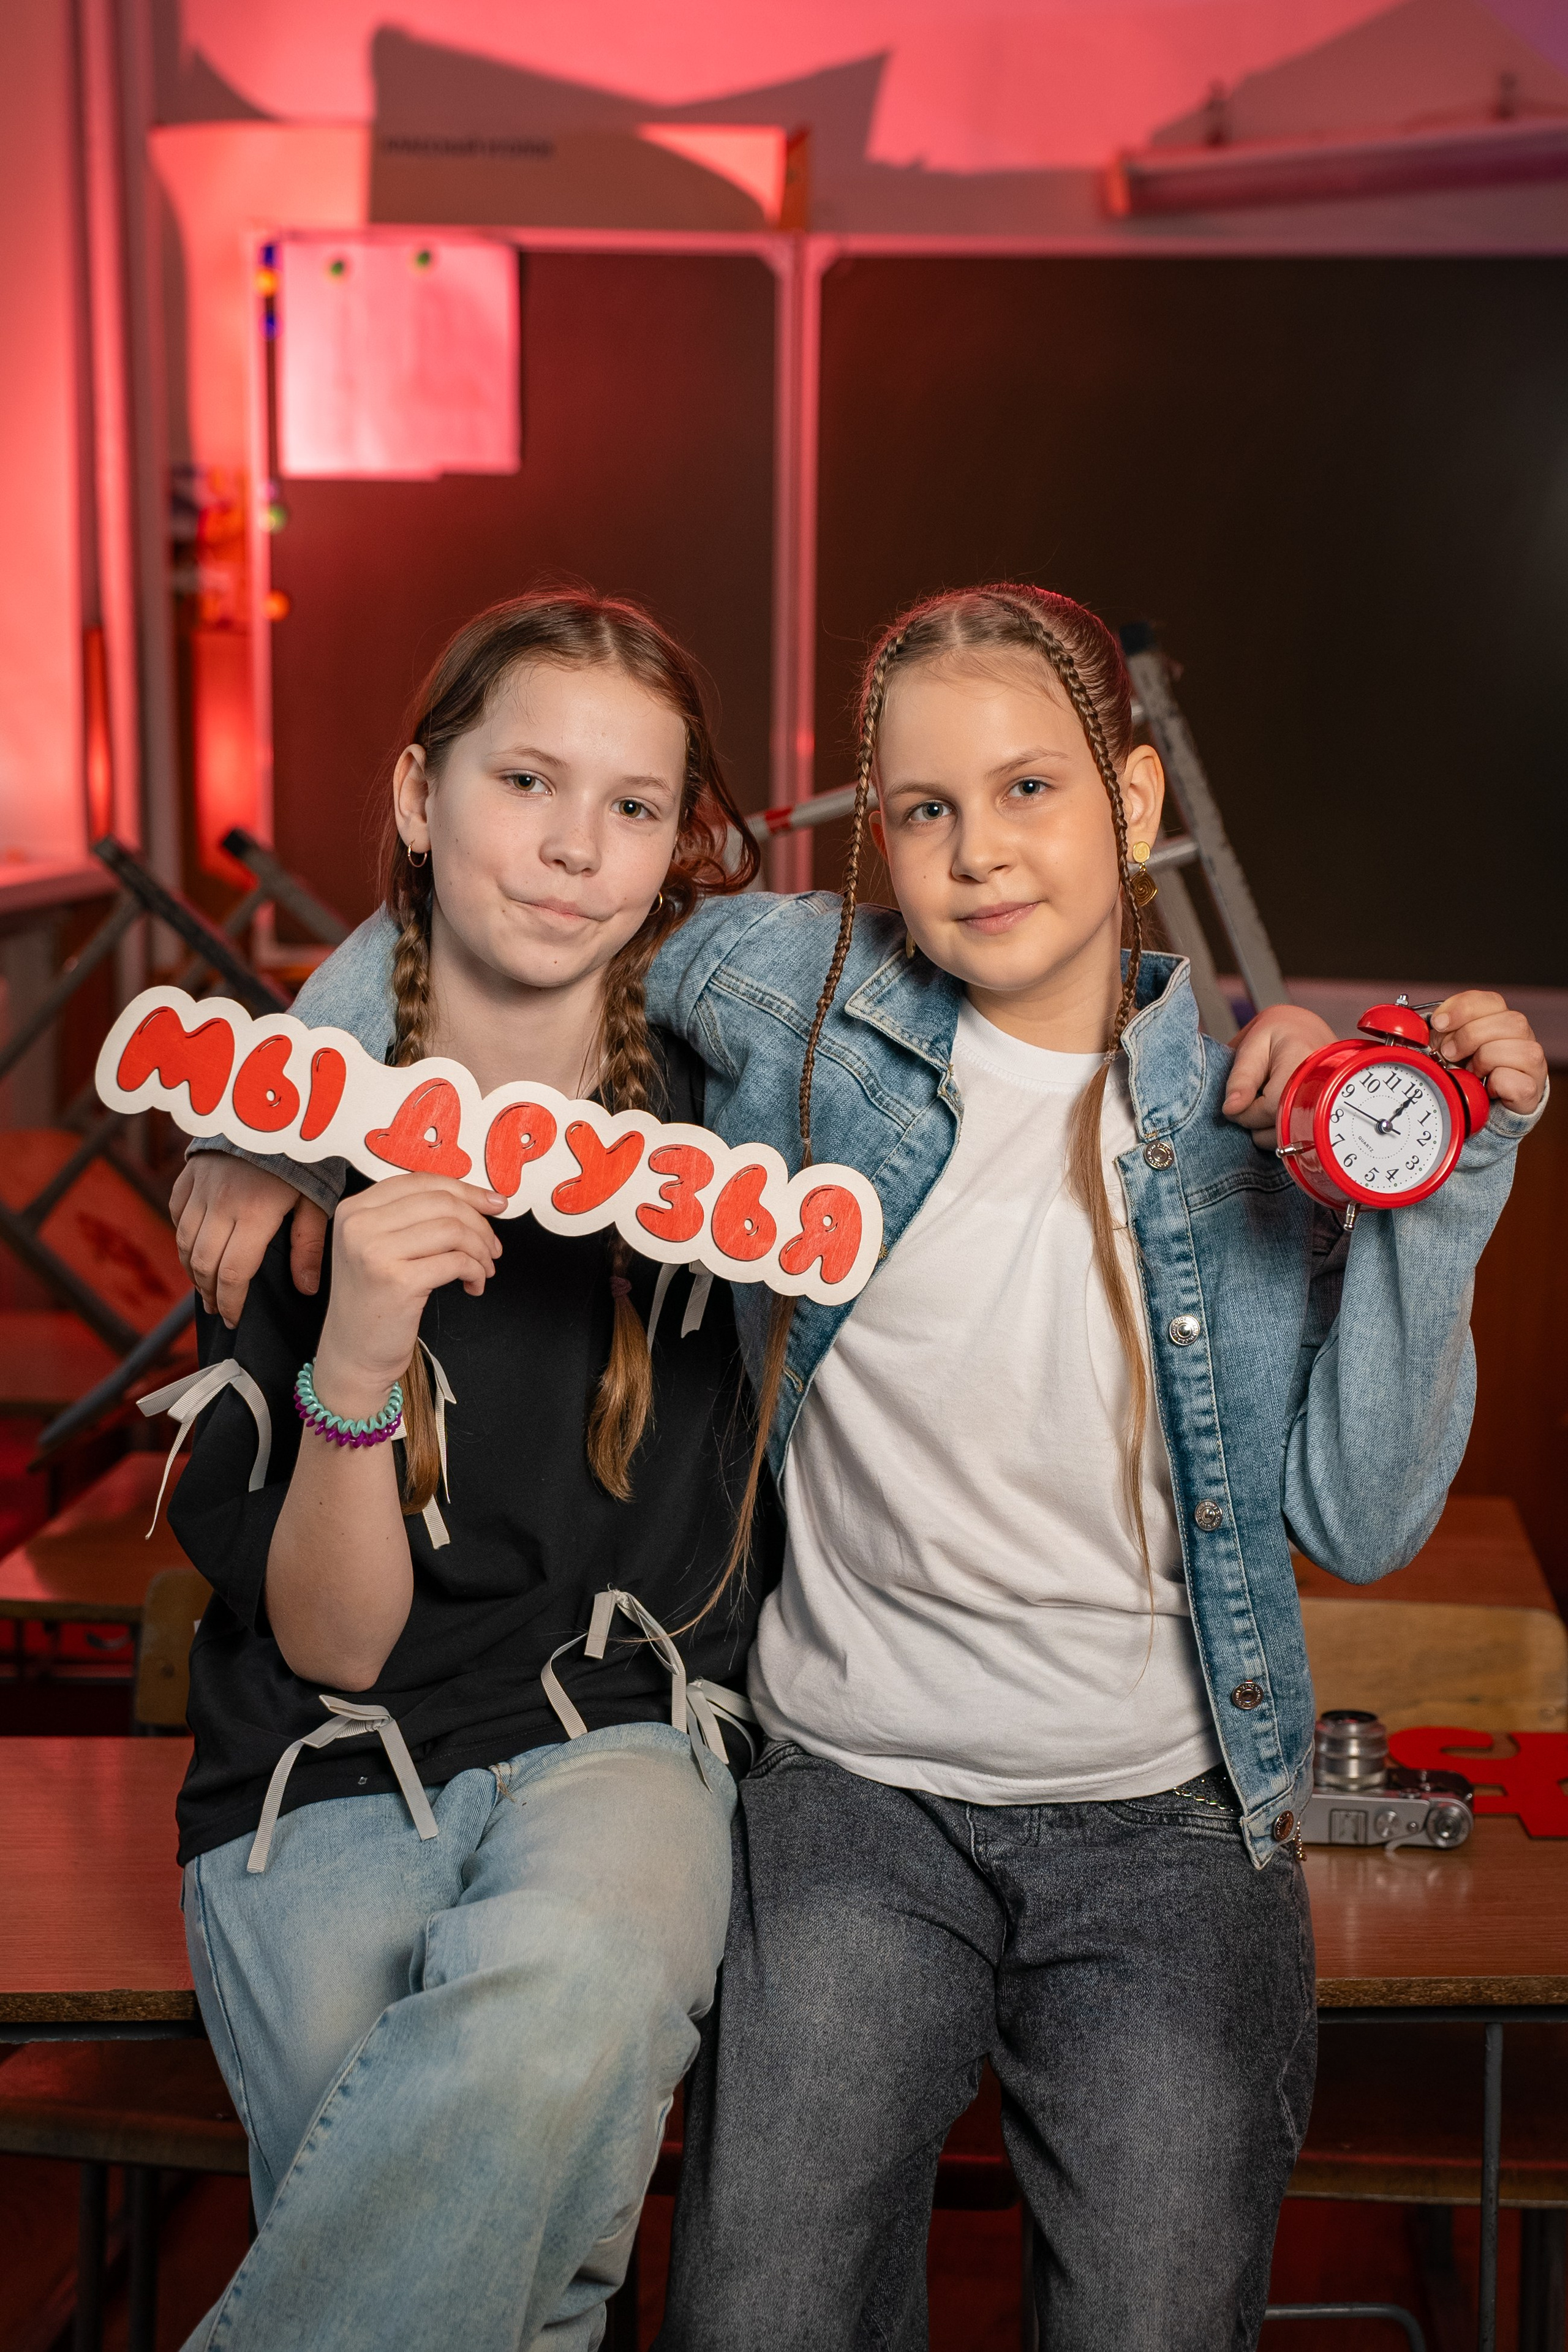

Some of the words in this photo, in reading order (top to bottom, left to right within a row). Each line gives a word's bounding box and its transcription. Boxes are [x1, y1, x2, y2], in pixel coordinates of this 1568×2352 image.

[1359, 1071, 1381, 1093] 10
[1382, 1071, 1402, 1093] 11
[1341, 1084, 1355, 1098] 9
[1401, 1082, 1423, 1105] 12
[1330, 1108, 1344, 1123] 8
[1417, 1110, 1431, 1127] 1
[116, 1006, 347, 1142] МЫ
[366, 1077, 862, 1284] ДРУЗЬЯ
[1331, 1133, 1346, 1147] 7
[1358, 1136, 1374, 1153] QUARTZ
[1416, 1131, 1431, 1147] 2
[1343, 1153, 1357, 1167] 6
[1405, 1155, 1420, 1170] 3
[1364, 1167, 1380, 1182] 5
[1385, 1168, 1400, 1183] 4
